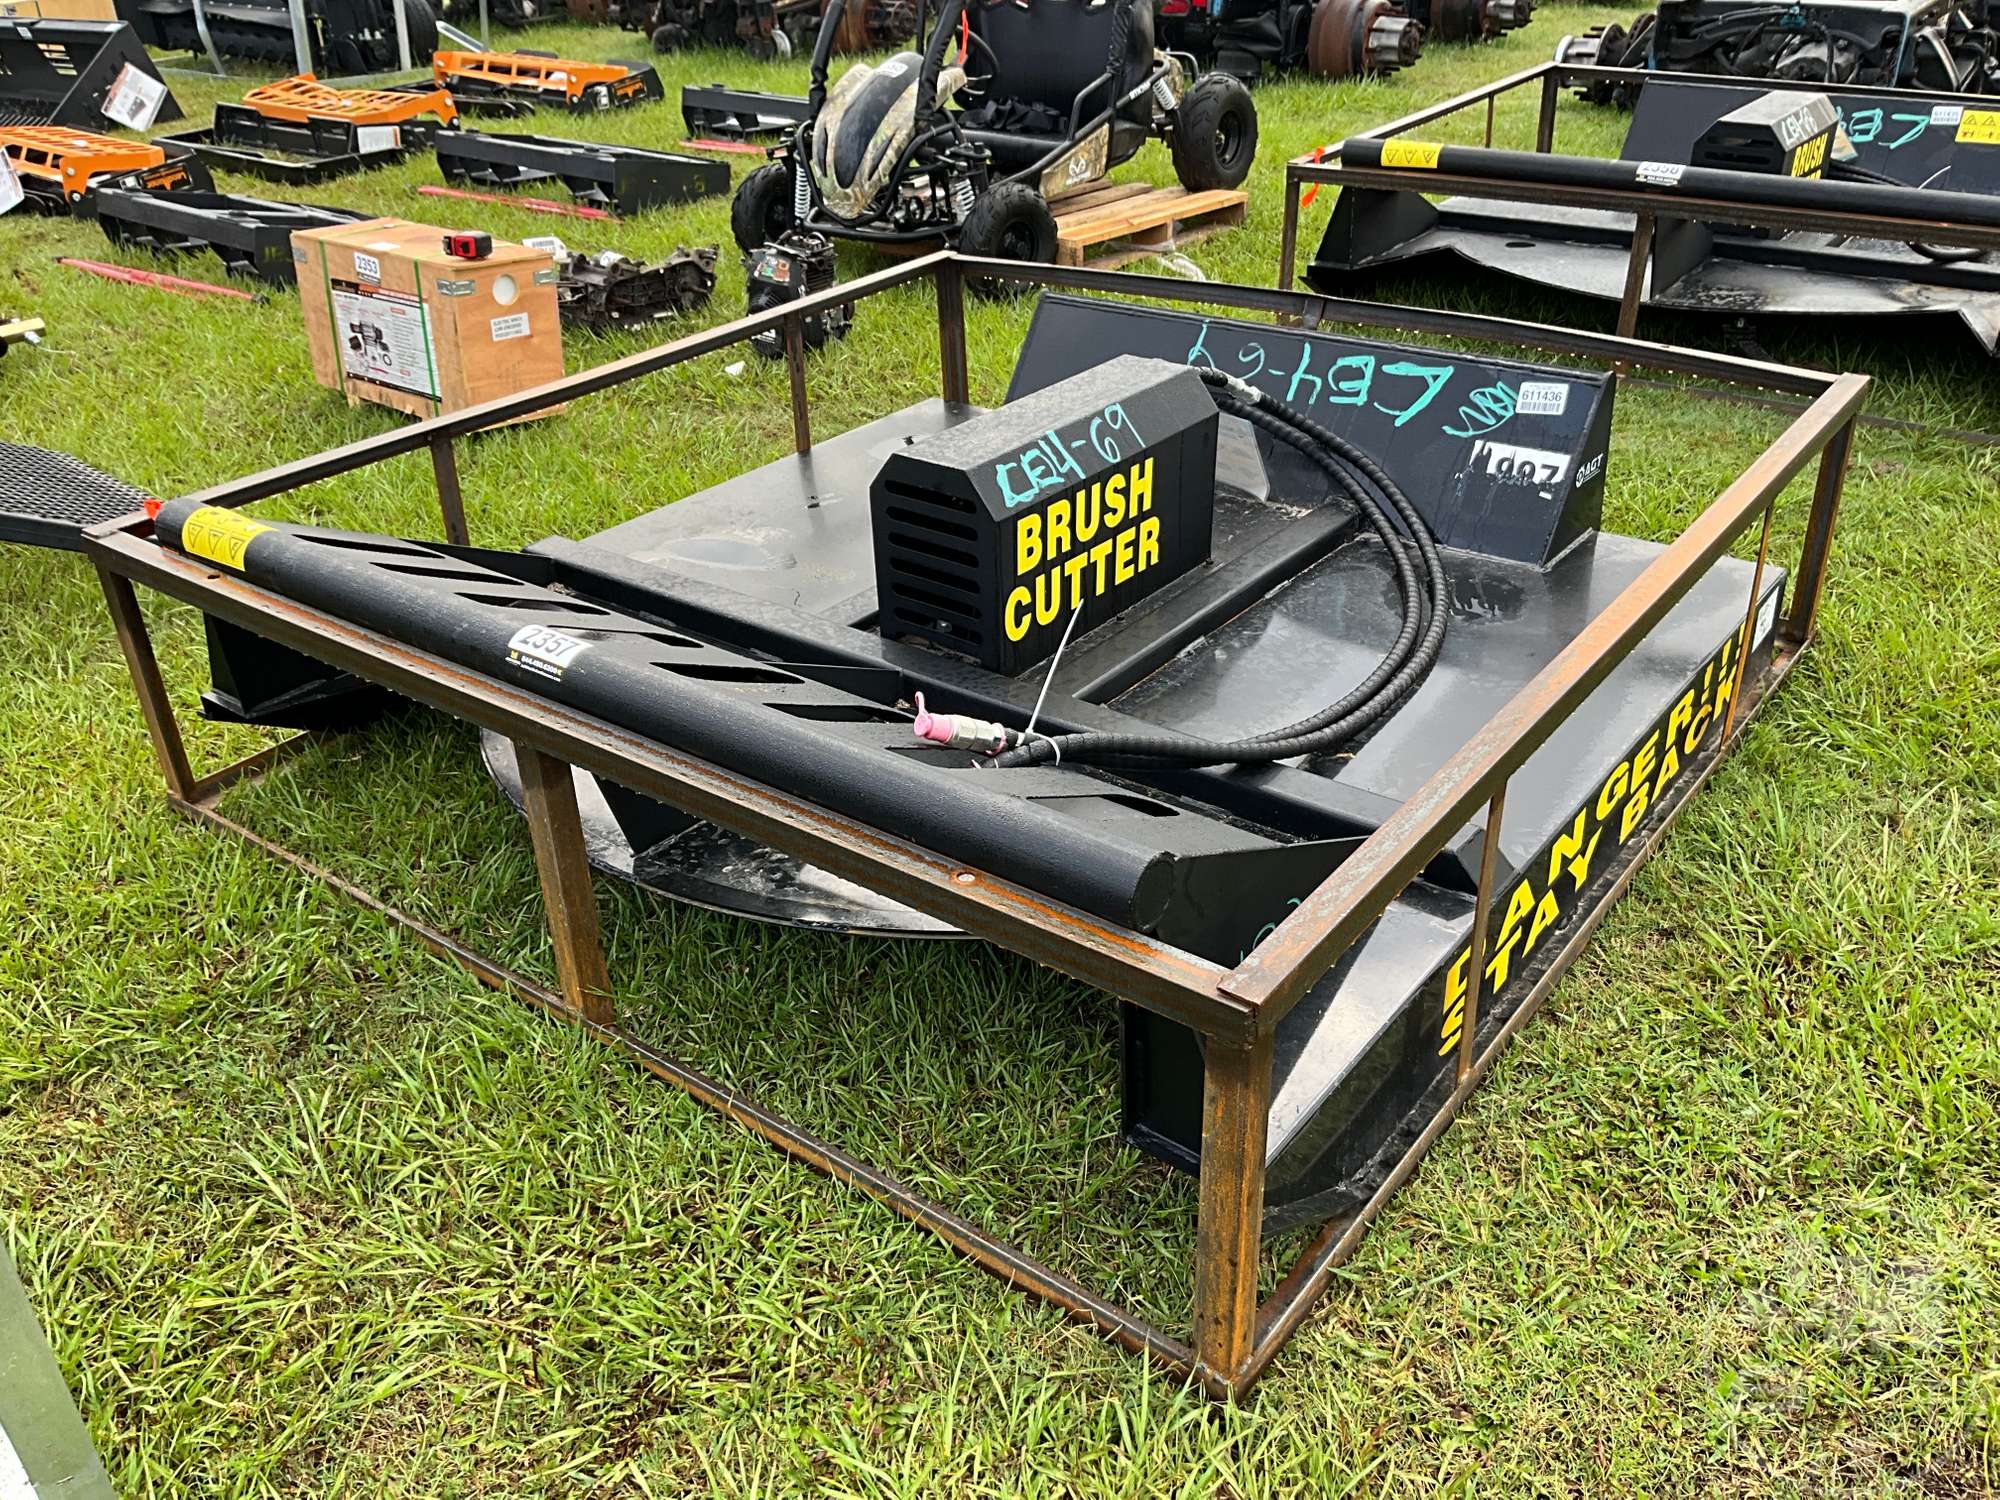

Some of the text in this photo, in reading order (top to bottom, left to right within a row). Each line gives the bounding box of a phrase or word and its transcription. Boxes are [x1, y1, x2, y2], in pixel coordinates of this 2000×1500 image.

[1791, 132, 1828, 178] BRUSH
[356, 255, 378, 274] 2353
[1522, 389, 1563, 402] 611436
[1017, 457, 1154, 577] BRUSH
[1005, 516, 1160, 642] CUTTER
[517, 628, 581, 657] 2357
[1438, 664, 1737, 1057] STAY BACK
